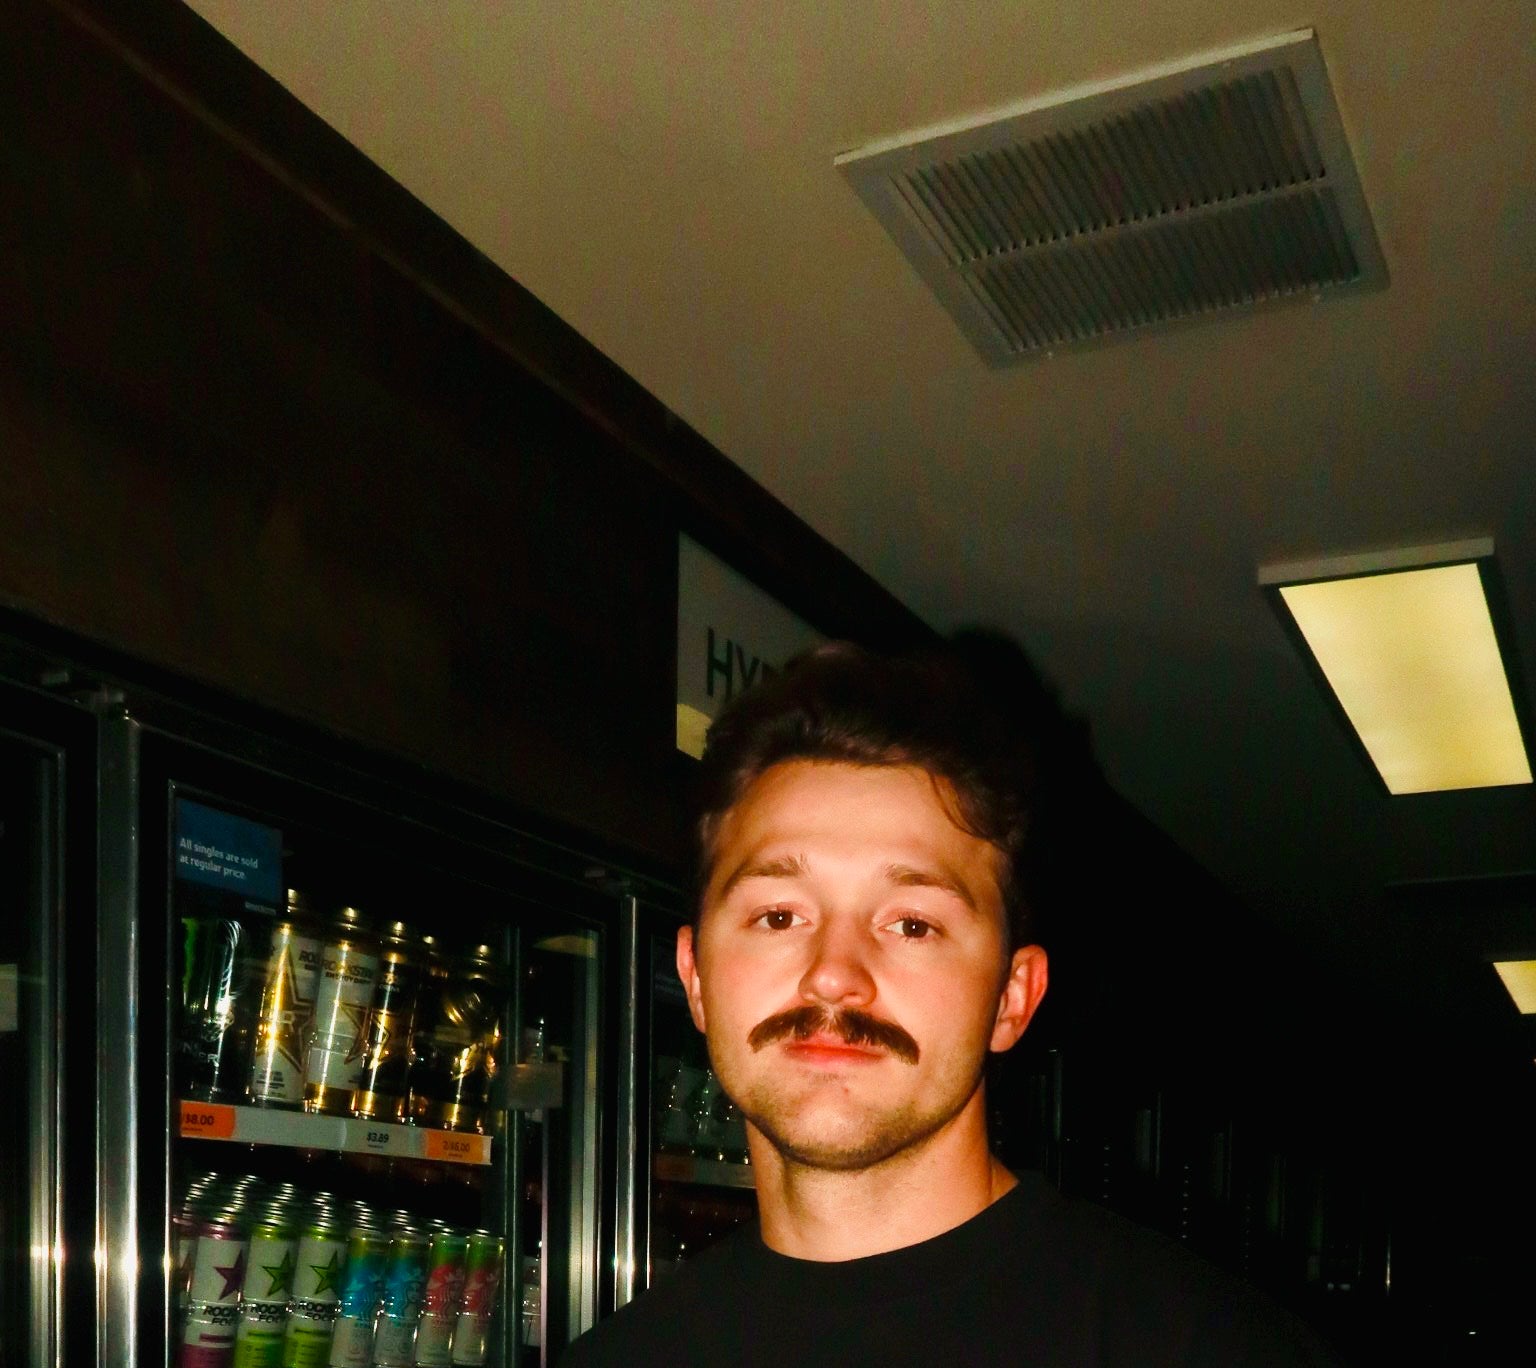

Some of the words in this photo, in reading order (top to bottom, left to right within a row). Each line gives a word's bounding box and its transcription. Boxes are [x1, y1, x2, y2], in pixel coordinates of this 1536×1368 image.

[707, 627, 772, 703] HY
[179, 837, 192, 850] All
[193, 844, 224, 859] singles
[225, 853, 240, 864] are
[241, 857, 258, 869] sold
[180, 855, 189, 865] at
[191, 858, 222, 872] regular
